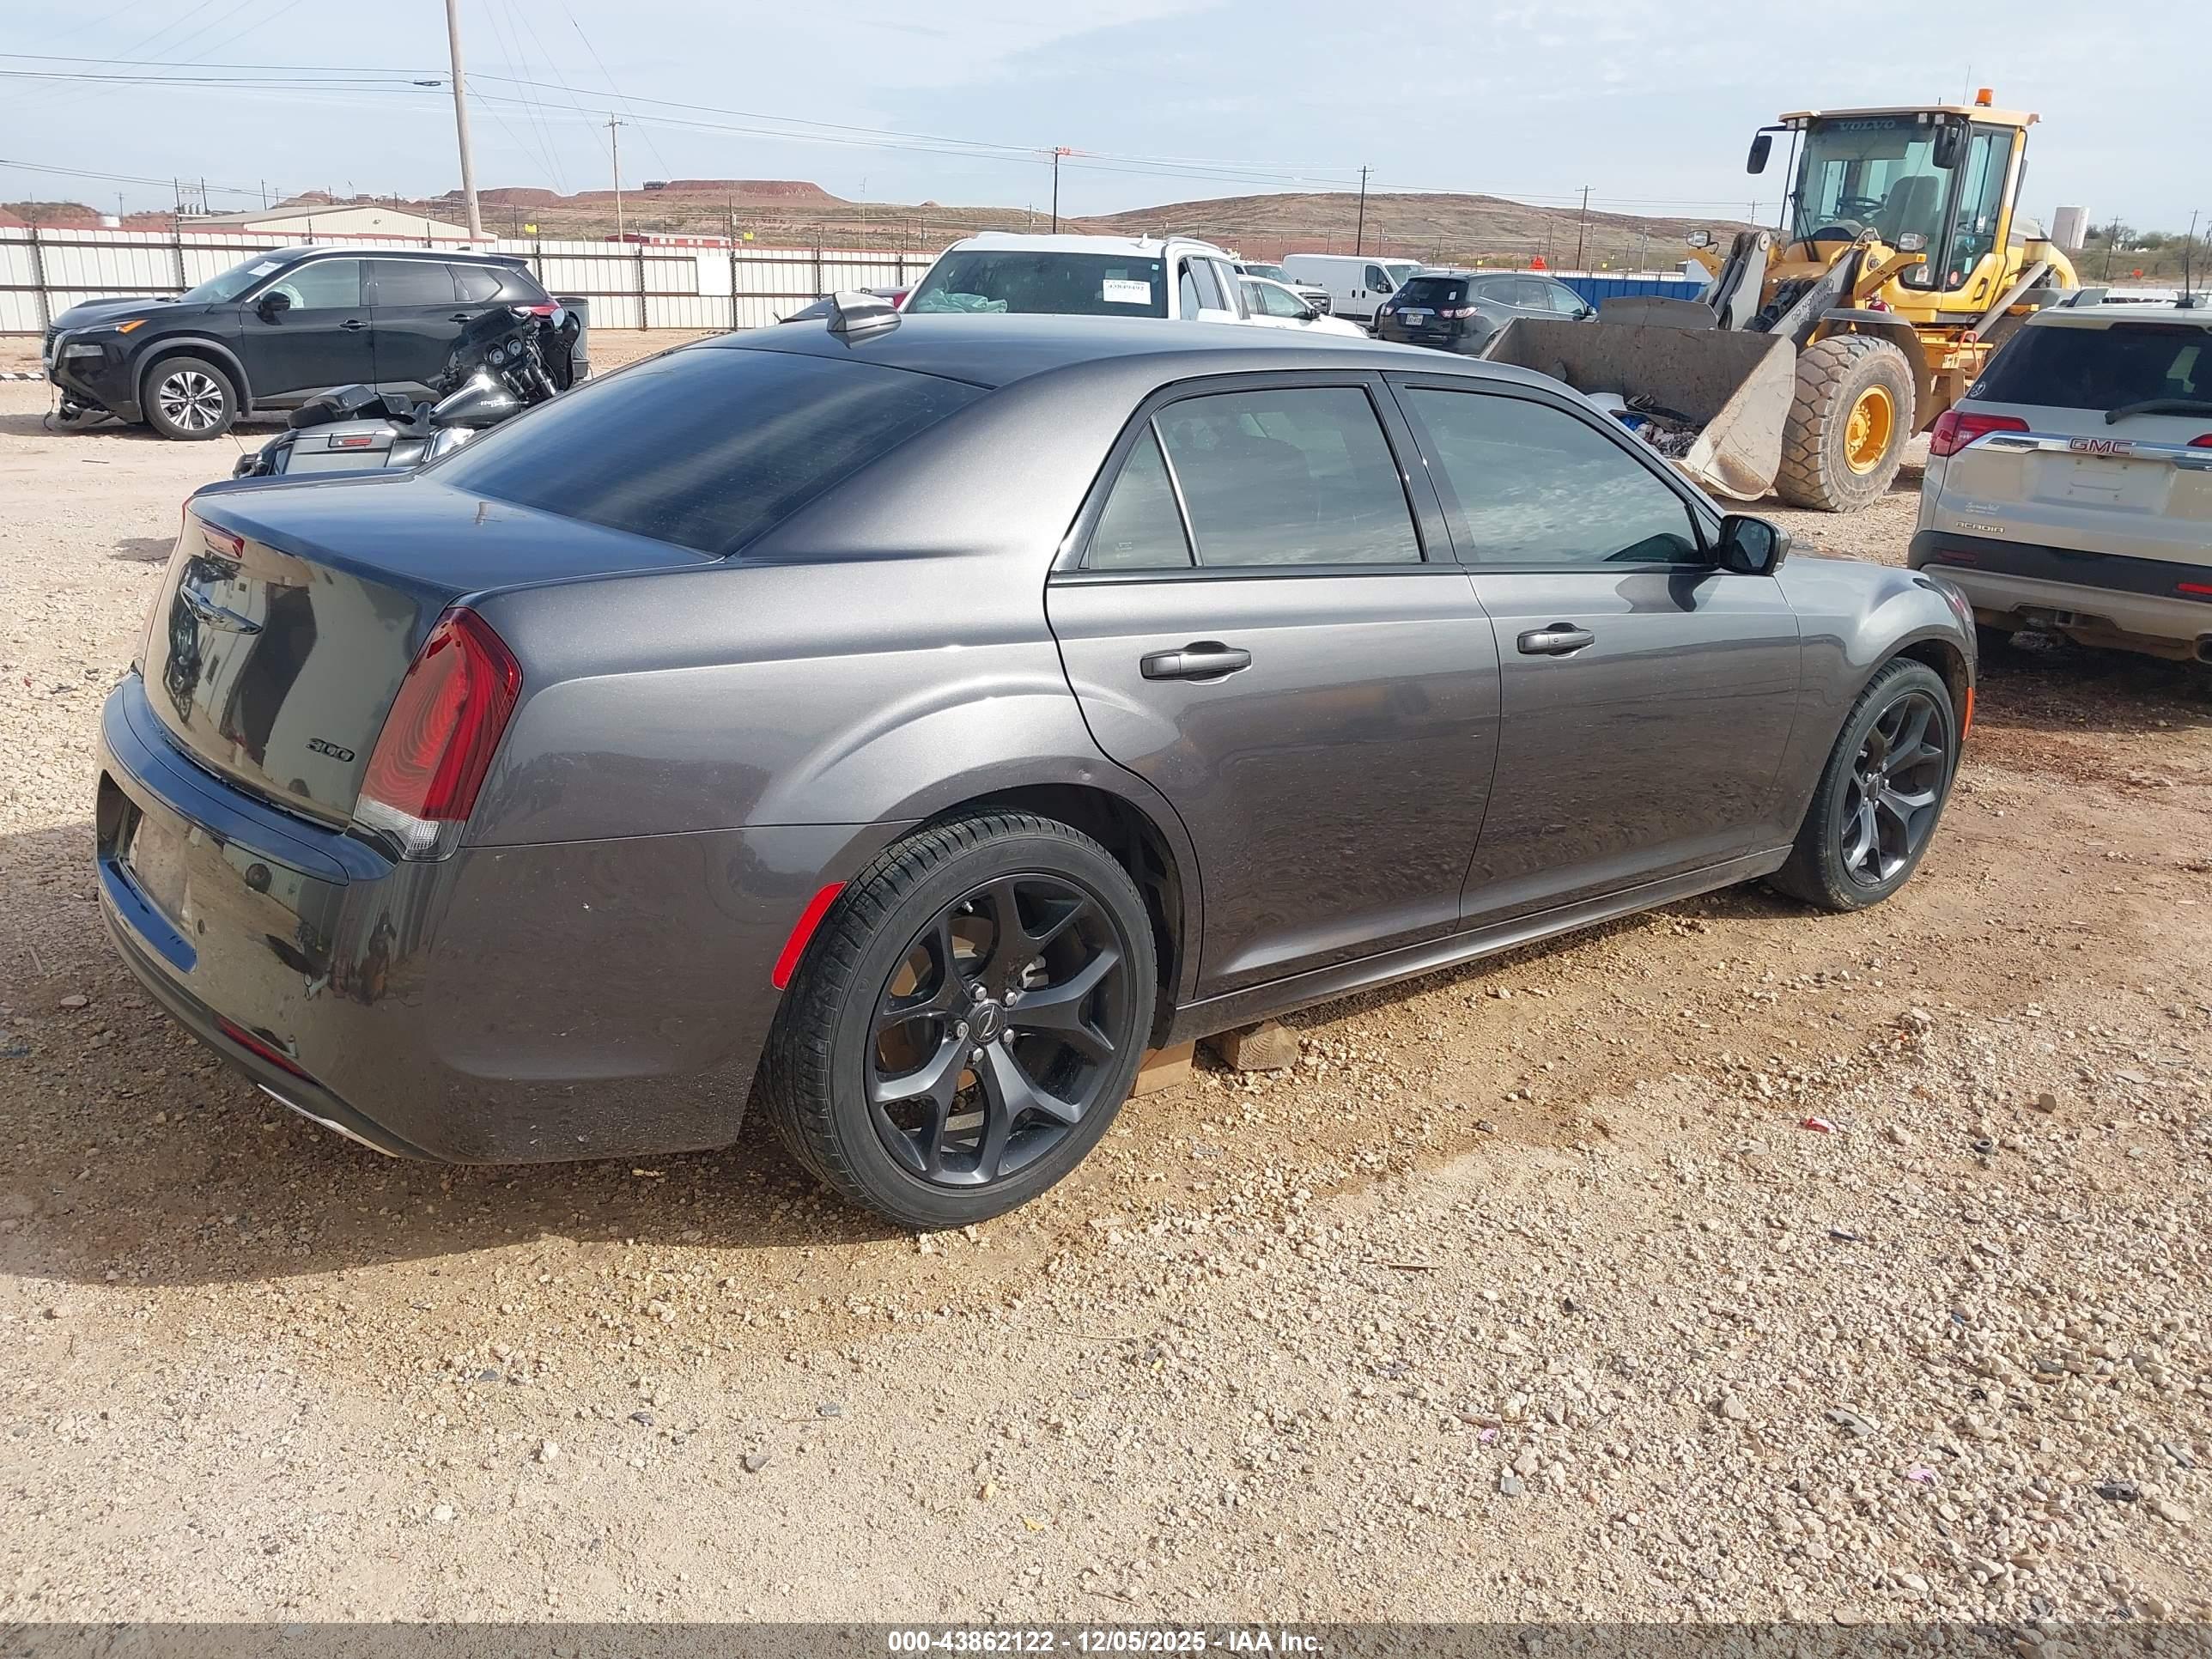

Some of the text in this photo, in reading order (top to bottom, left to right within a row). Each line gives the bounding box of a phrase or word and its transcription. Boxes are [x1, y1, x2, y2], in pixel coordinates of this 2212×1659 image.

[1839, 119, 1896, 131] VOLVO
[1791, 308, 1802, 321] DO
[1802, 293, 1815, 311] NOT
[2069, 437, 2135, 456] GMC
[1956, 521, 2005, 533] ACADIA
[305, 738, 356, 763] 300
